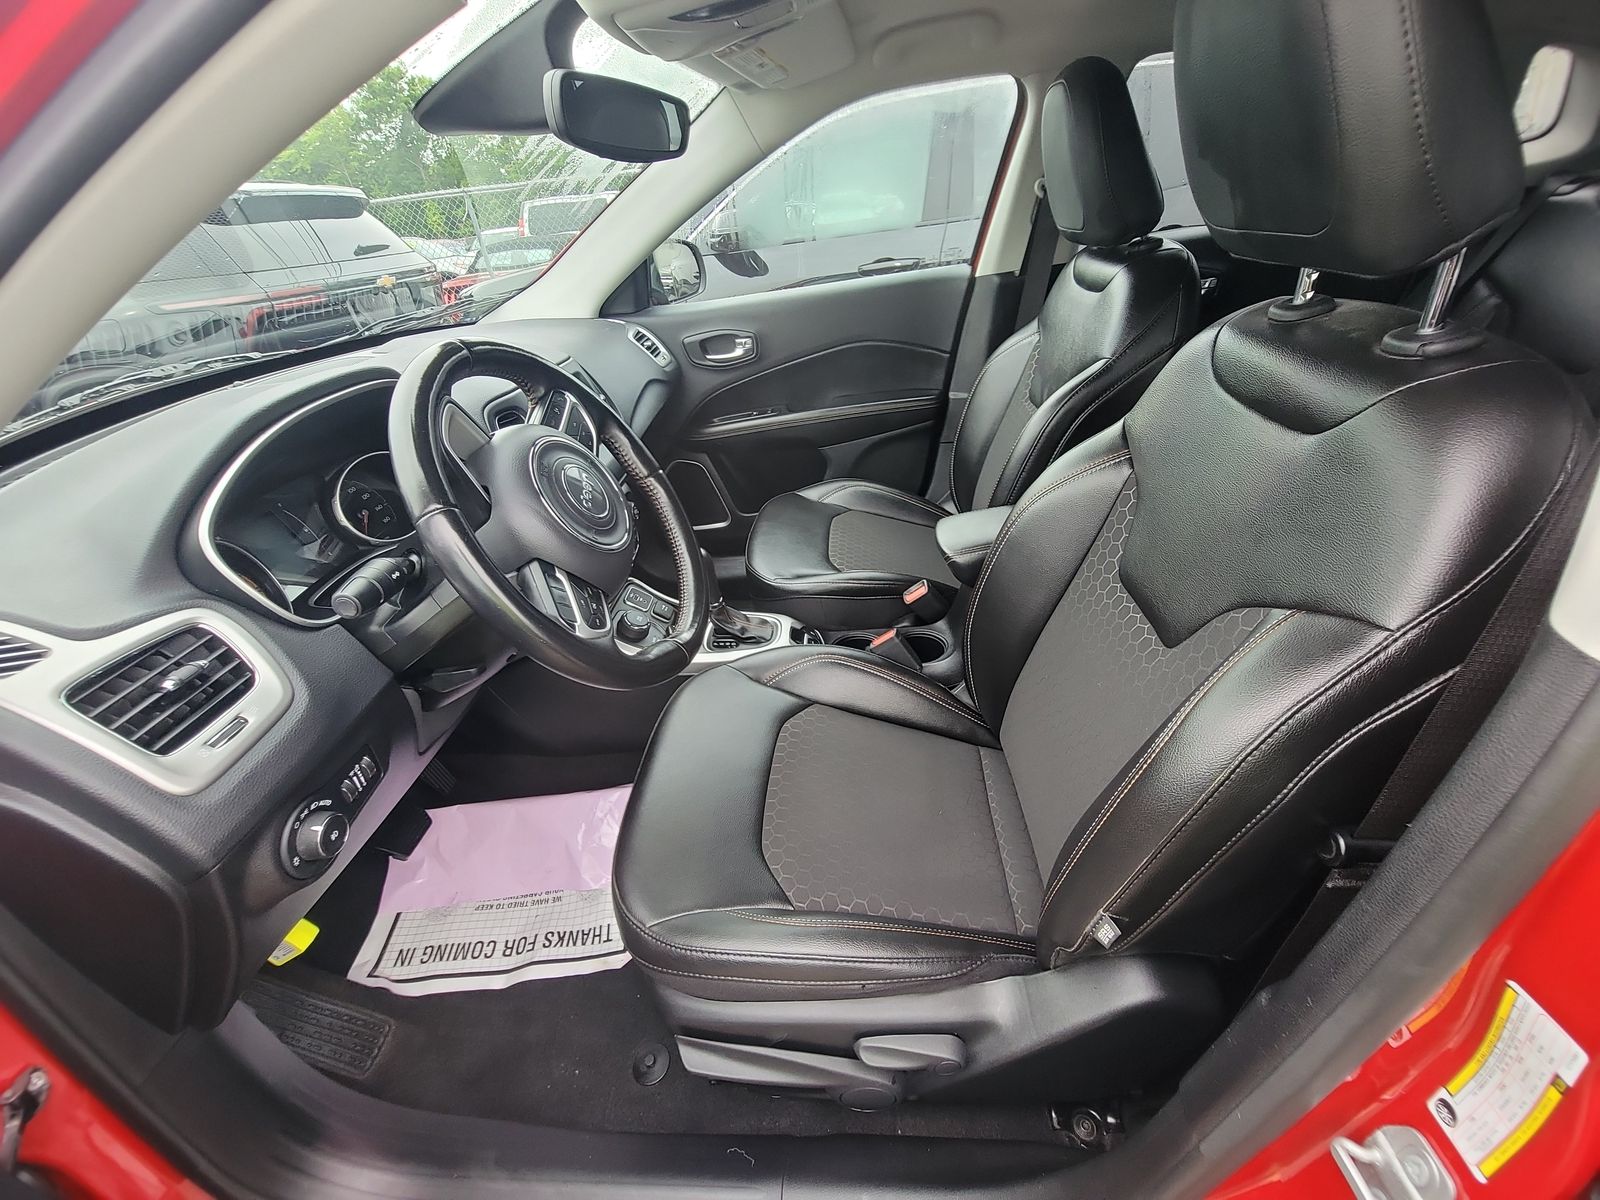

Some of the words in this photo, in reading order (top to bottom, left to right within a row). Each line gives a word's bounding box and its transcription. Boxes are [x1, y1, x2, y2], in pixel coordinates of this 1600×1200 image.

[507, 899, 528, 909] TRIED
[530, 897, 549, 907] HAVE
[551, 895, 562, 904] WE
[474, 904, 493, 912] KEEP
[543, 923, 613, 949] THANKS
[420, 940, 497, 965] COMING
[502, 934, 536, 957] FOR
[394, 948, 415, 967] IN
